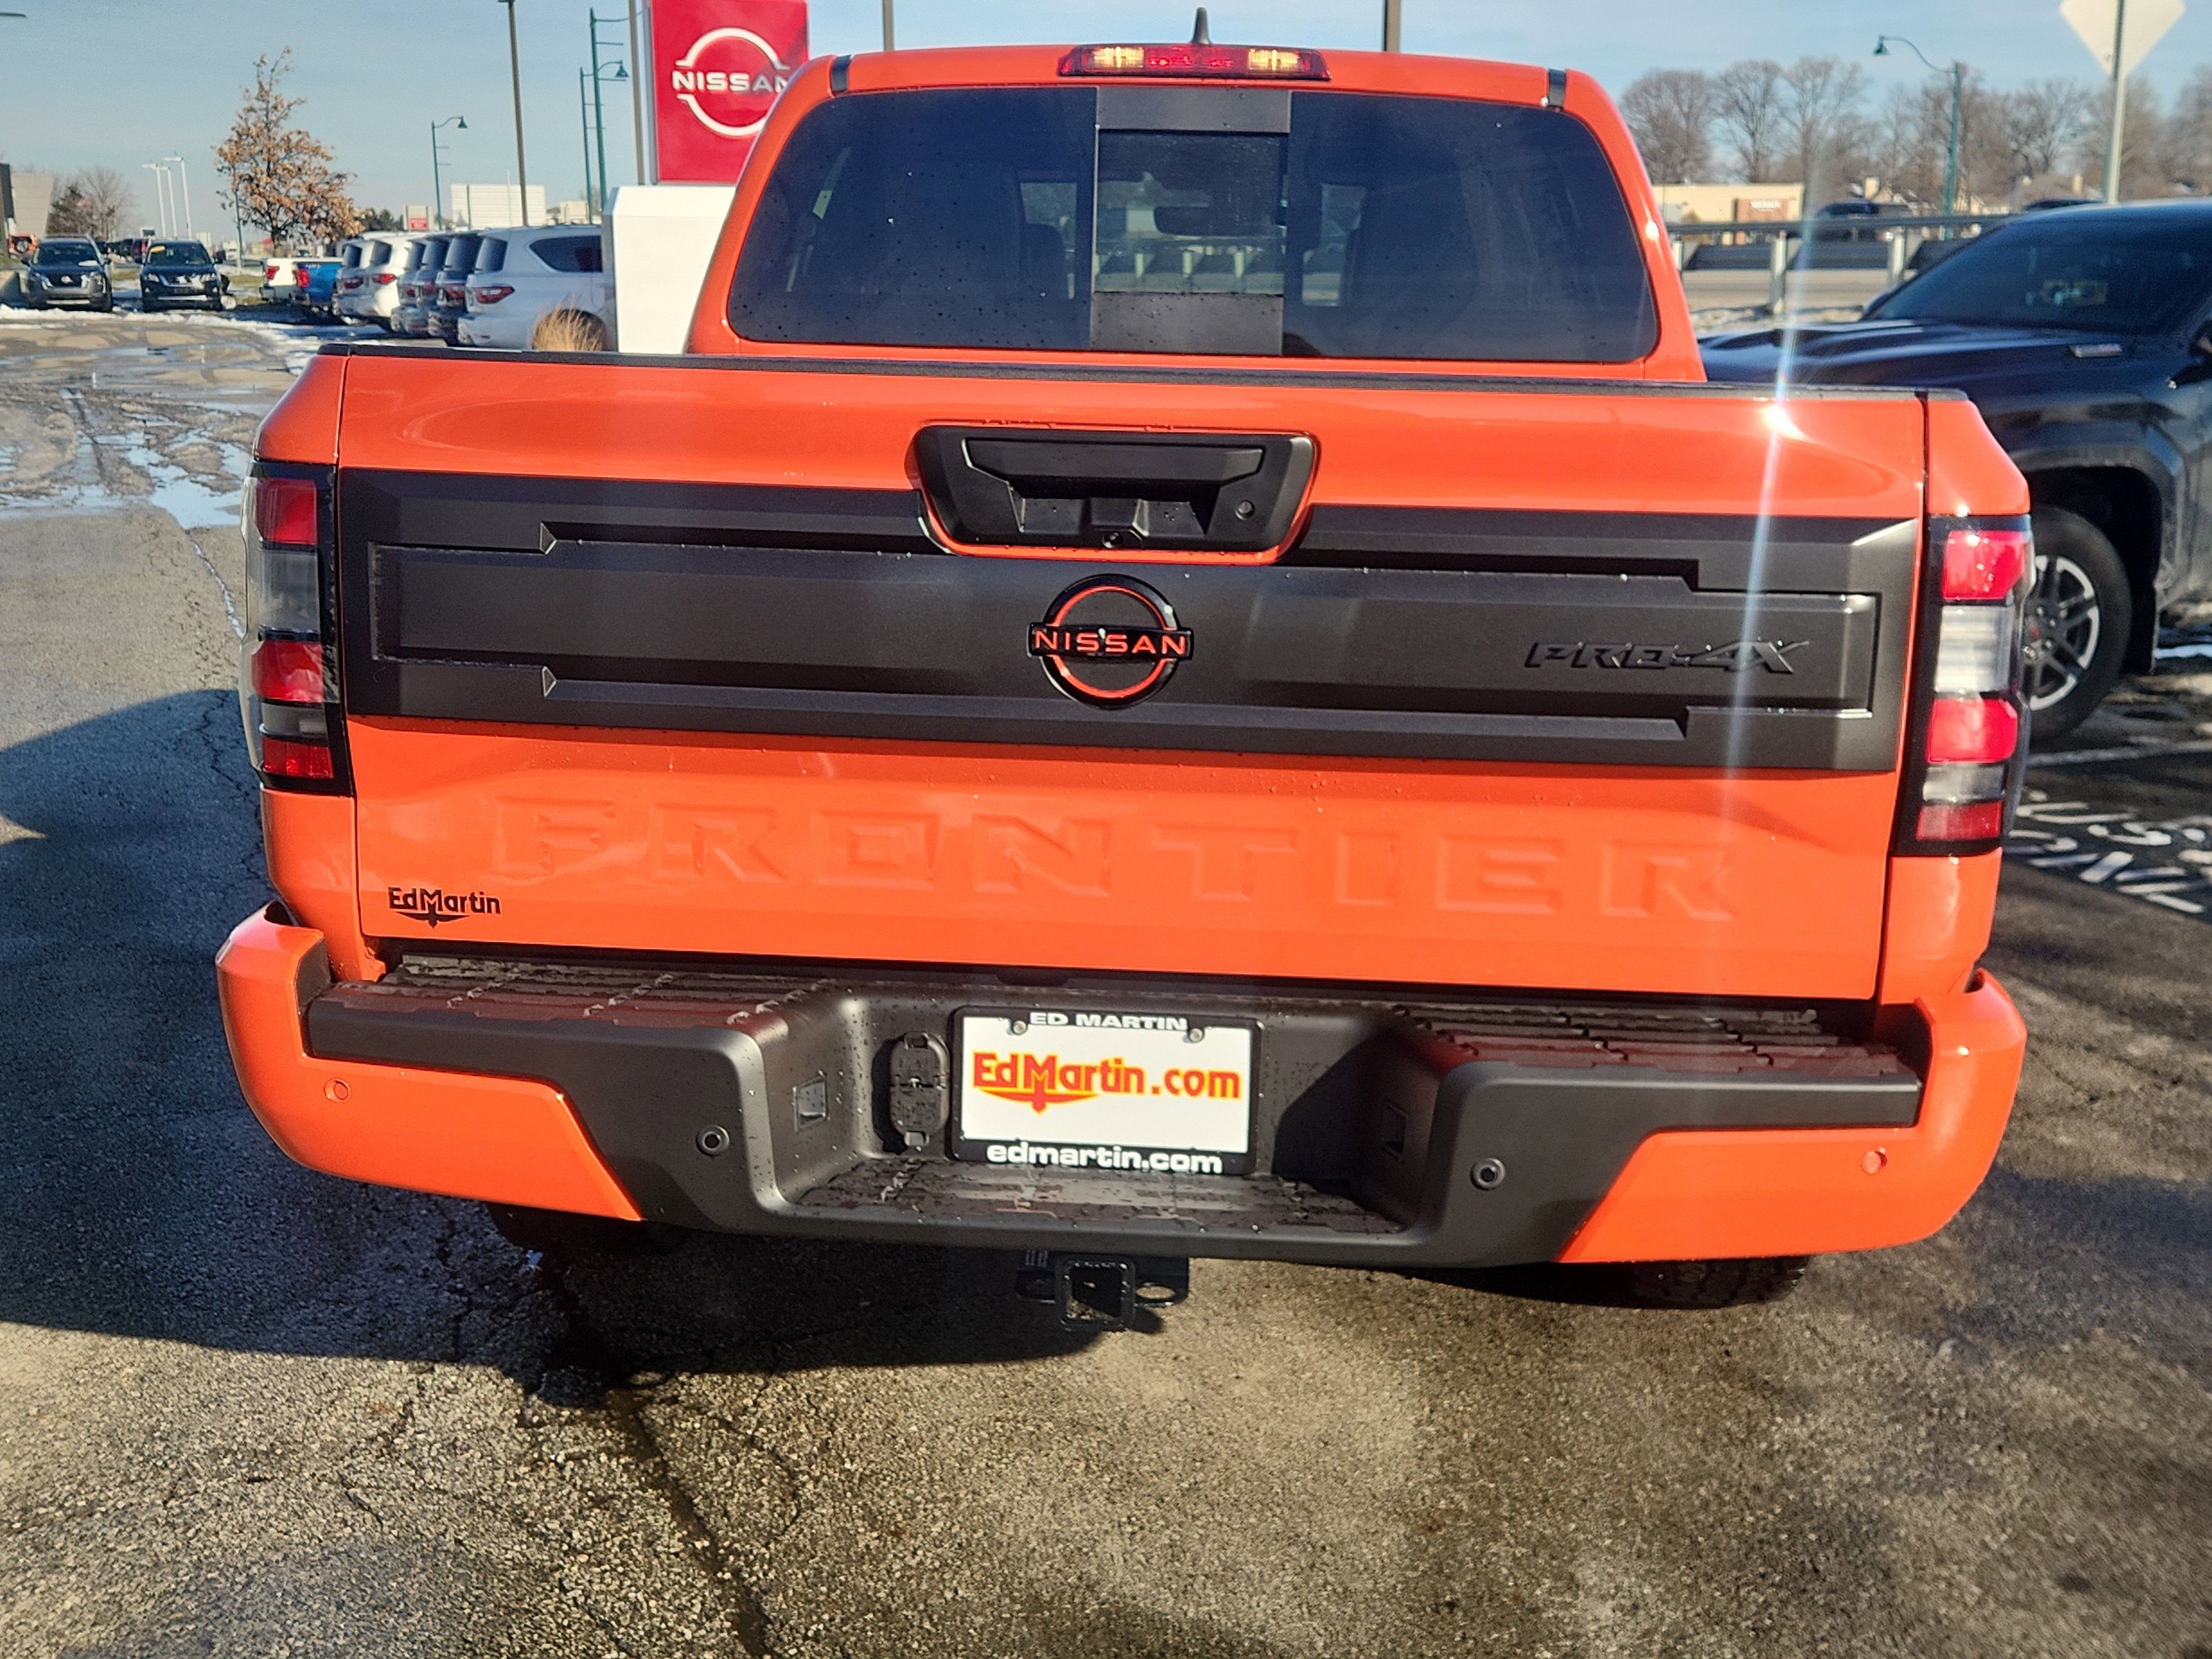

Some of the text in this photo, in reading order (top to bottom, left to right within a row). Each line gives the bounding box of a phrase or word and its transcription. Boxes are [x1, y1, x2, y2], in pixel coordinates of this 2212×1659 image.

[1034, 629, 1186, 655] NISSAN
[1525, 640, 1810, 674] PRO-4X
[491, 794, 1734, 923] FRONTIER
[1030, 1012, 1187, 1030] ED MARTIN
[986, 1142, 1223, 1174] edmartin.com
